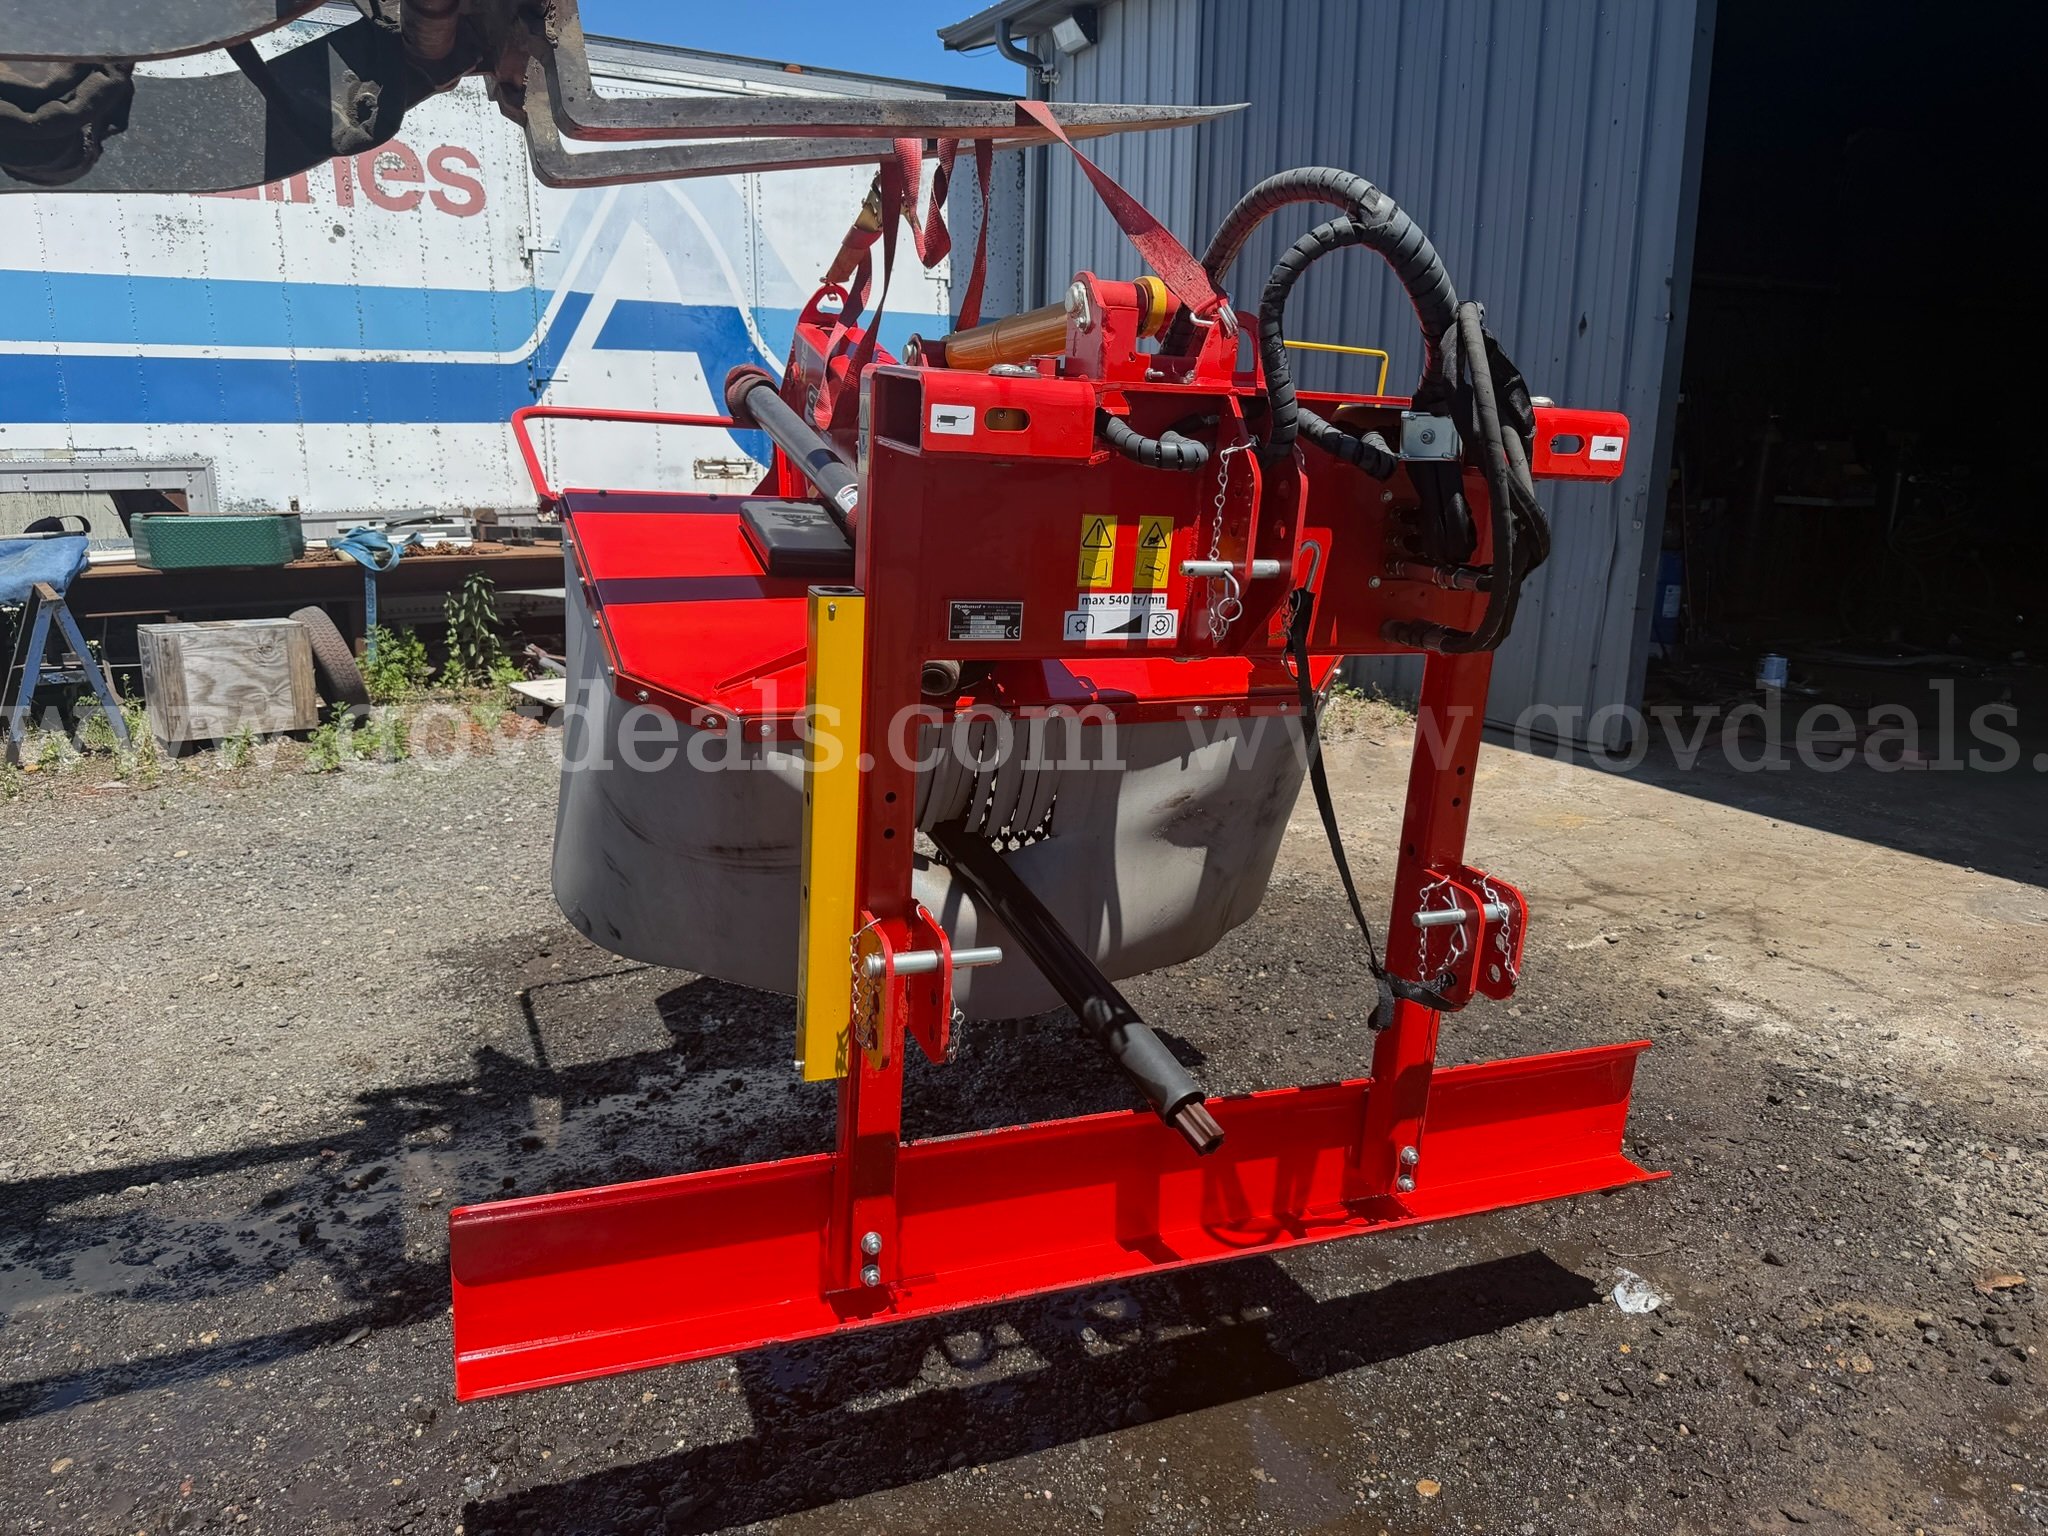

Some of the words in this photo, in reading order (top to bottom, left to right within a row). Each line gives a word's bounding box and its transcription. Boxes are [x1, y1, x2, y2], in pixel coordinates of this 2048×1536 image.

[1081, 596, 1105, 605] max
[1109, 595, 1129, 605] 540
[1133, 594, 1165, 606] tr/mn
